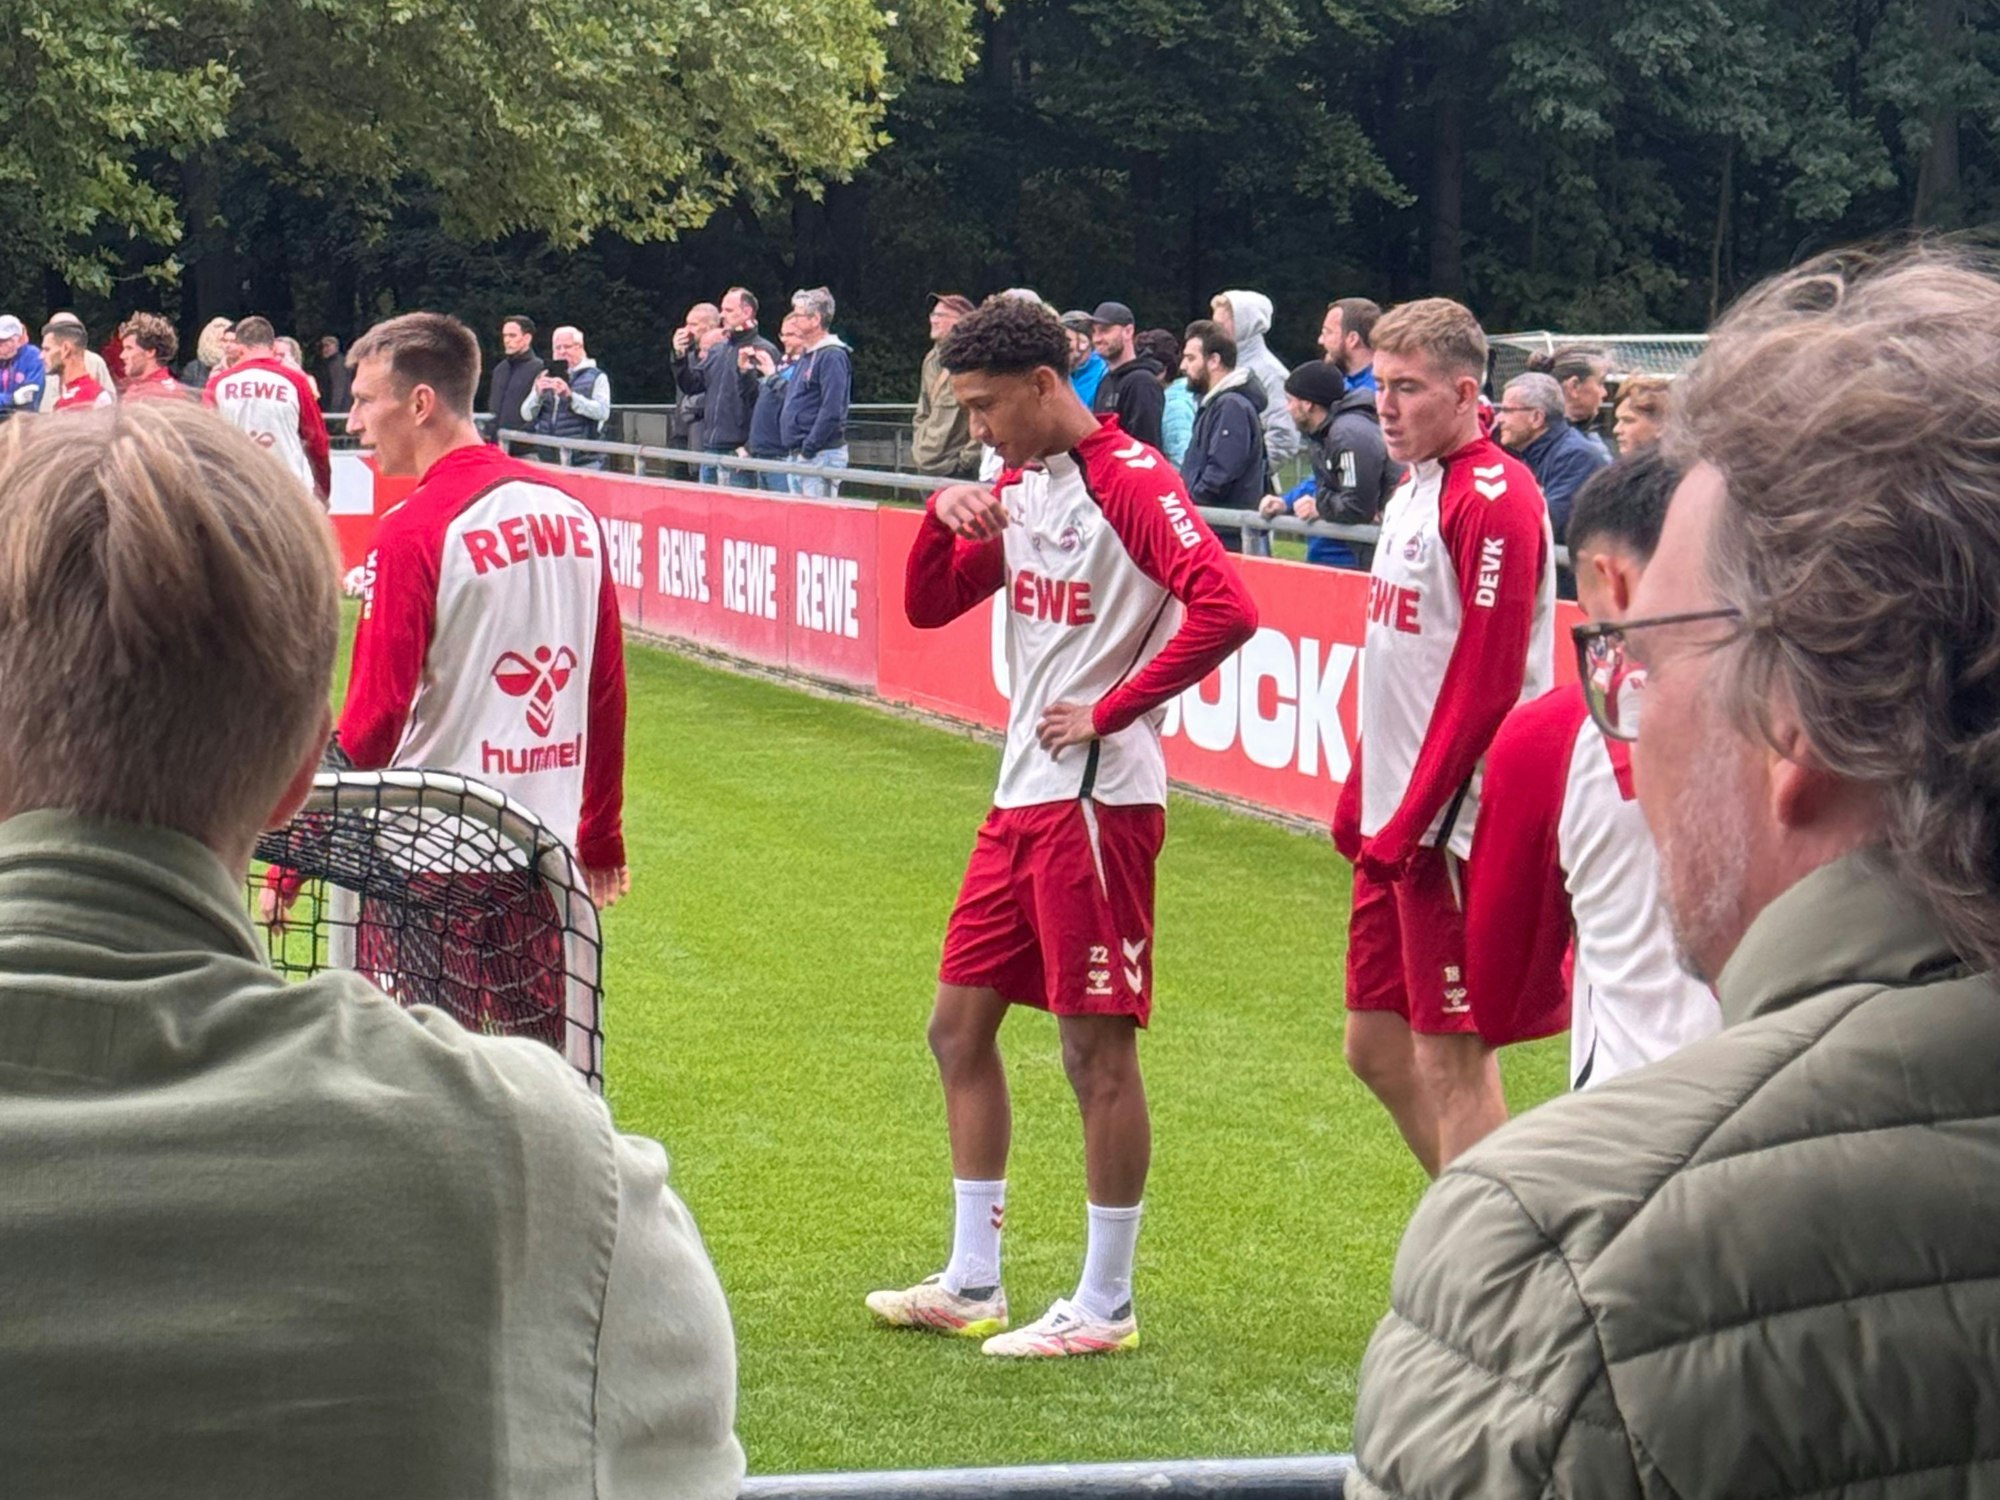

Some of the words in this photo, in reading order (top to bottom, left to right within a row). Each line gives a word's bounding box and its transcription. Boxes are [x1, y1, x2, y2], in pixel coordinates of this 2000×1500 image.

[225, 381, 288, 403] REWE
[463, 514, 594, 575] REWE
[1157, 491, 1202, 549] DEVK
[658, 526, 710, 603] REWE
[723, 538, 777, 621] REWE
[796, 552, 859, 639] REWE
[1008, 567, 1096, 627] EWE
[1474, 537, 1504, 608] DEVK
[1089, 945, 1109, 964] 22
